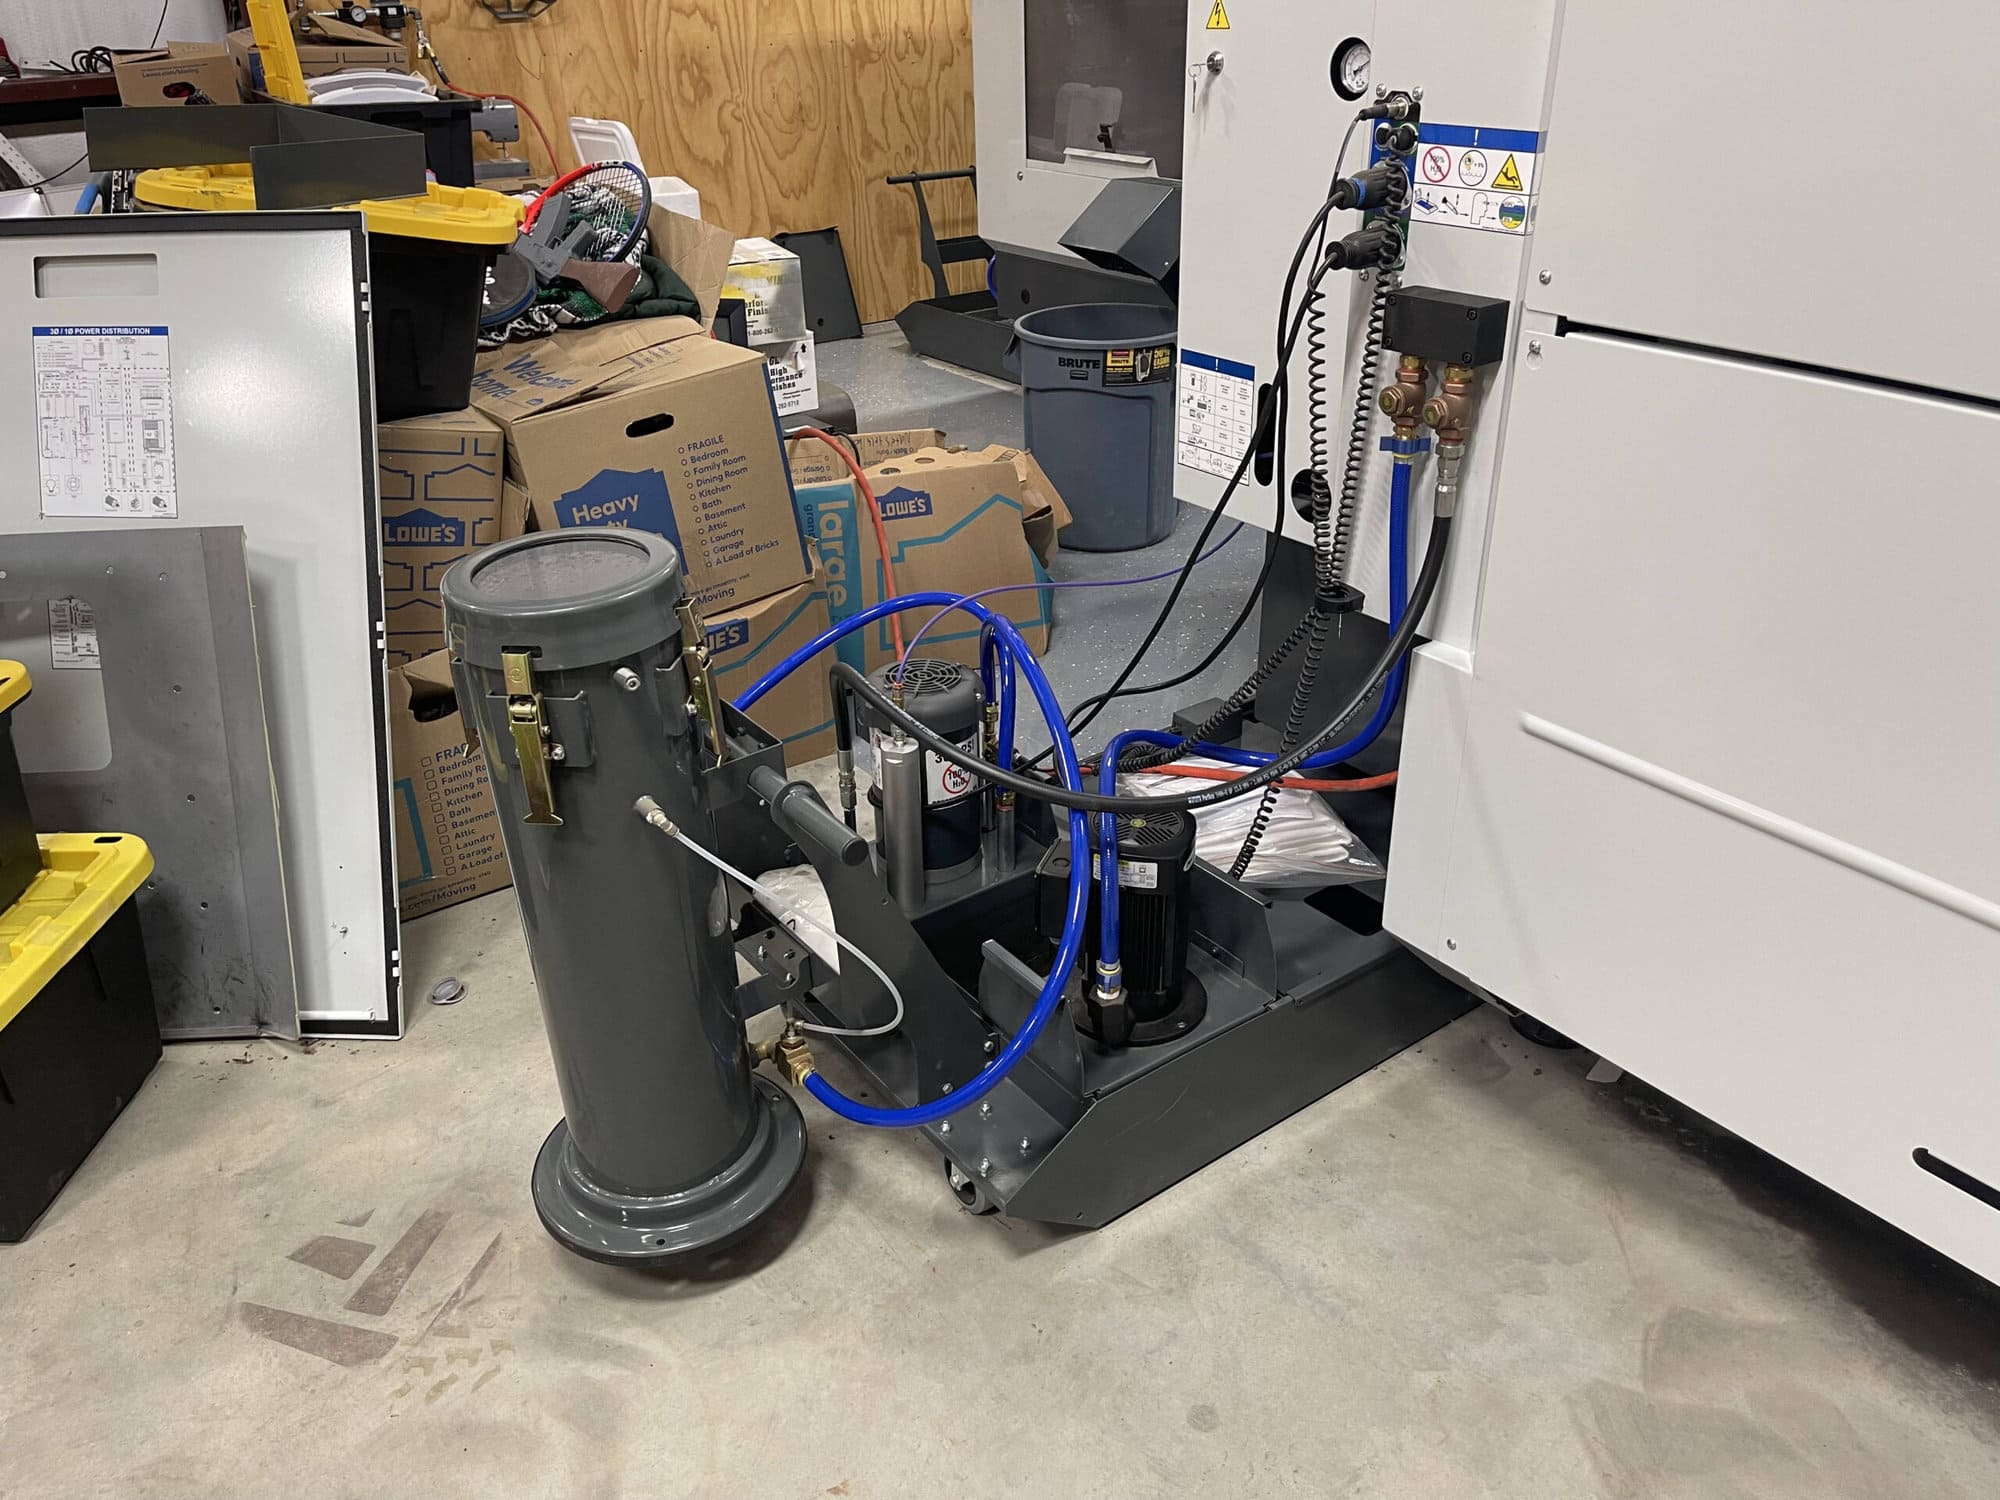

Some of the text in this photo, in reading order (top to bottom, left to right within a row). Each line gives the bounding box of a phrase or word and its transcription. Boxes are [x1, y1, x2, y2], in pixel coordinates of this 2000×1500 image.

[74, 327, 100, 335] POWER
[101, 327, 150, 335] DISTRIBUTION
[770, 366, 788, 377] High
[1058, 357, 1101, 369] BRUTE
[687, 434, 725, 452] FRAGILE
[690, 447, 729, 464] Bedroom
[693, 455, 746, 476] Family Room
[696, 466, 749, 488] Dining Room
[698, 484, 732, 498] Kitchen
[572, 494, 639, 525] Heavy
[702, 498, 722, 510] Bath
[704, 503, 746, 521] Basement
[384, 523, 457, 543] LOWE'S
[707, 520, 728, 533] Attic
[710, 527, 745, 544] Laundry
[712, 540, 745, 555] Garage
[716, 538, 780, 566] A Load of Bricks
[697, 588, 735, 606] Moving
[438, 753, 481, 774] Bedroom
[441, 768, 473, 785] Family
[444, 781, 475, 796] Dining
[447, 790, 483, 808] Kitchen
[449, 805, 471, 819] Bath
[451, 809, 496, 829] Basemen
[454, 827, 476, 841] Attic
[456, 831, 496, 850] Laundry
[458, 845, 493, 861] Garage
[460, 851, 504, 871] A Load of
[402, 883, 477, 912] .com/Moving
